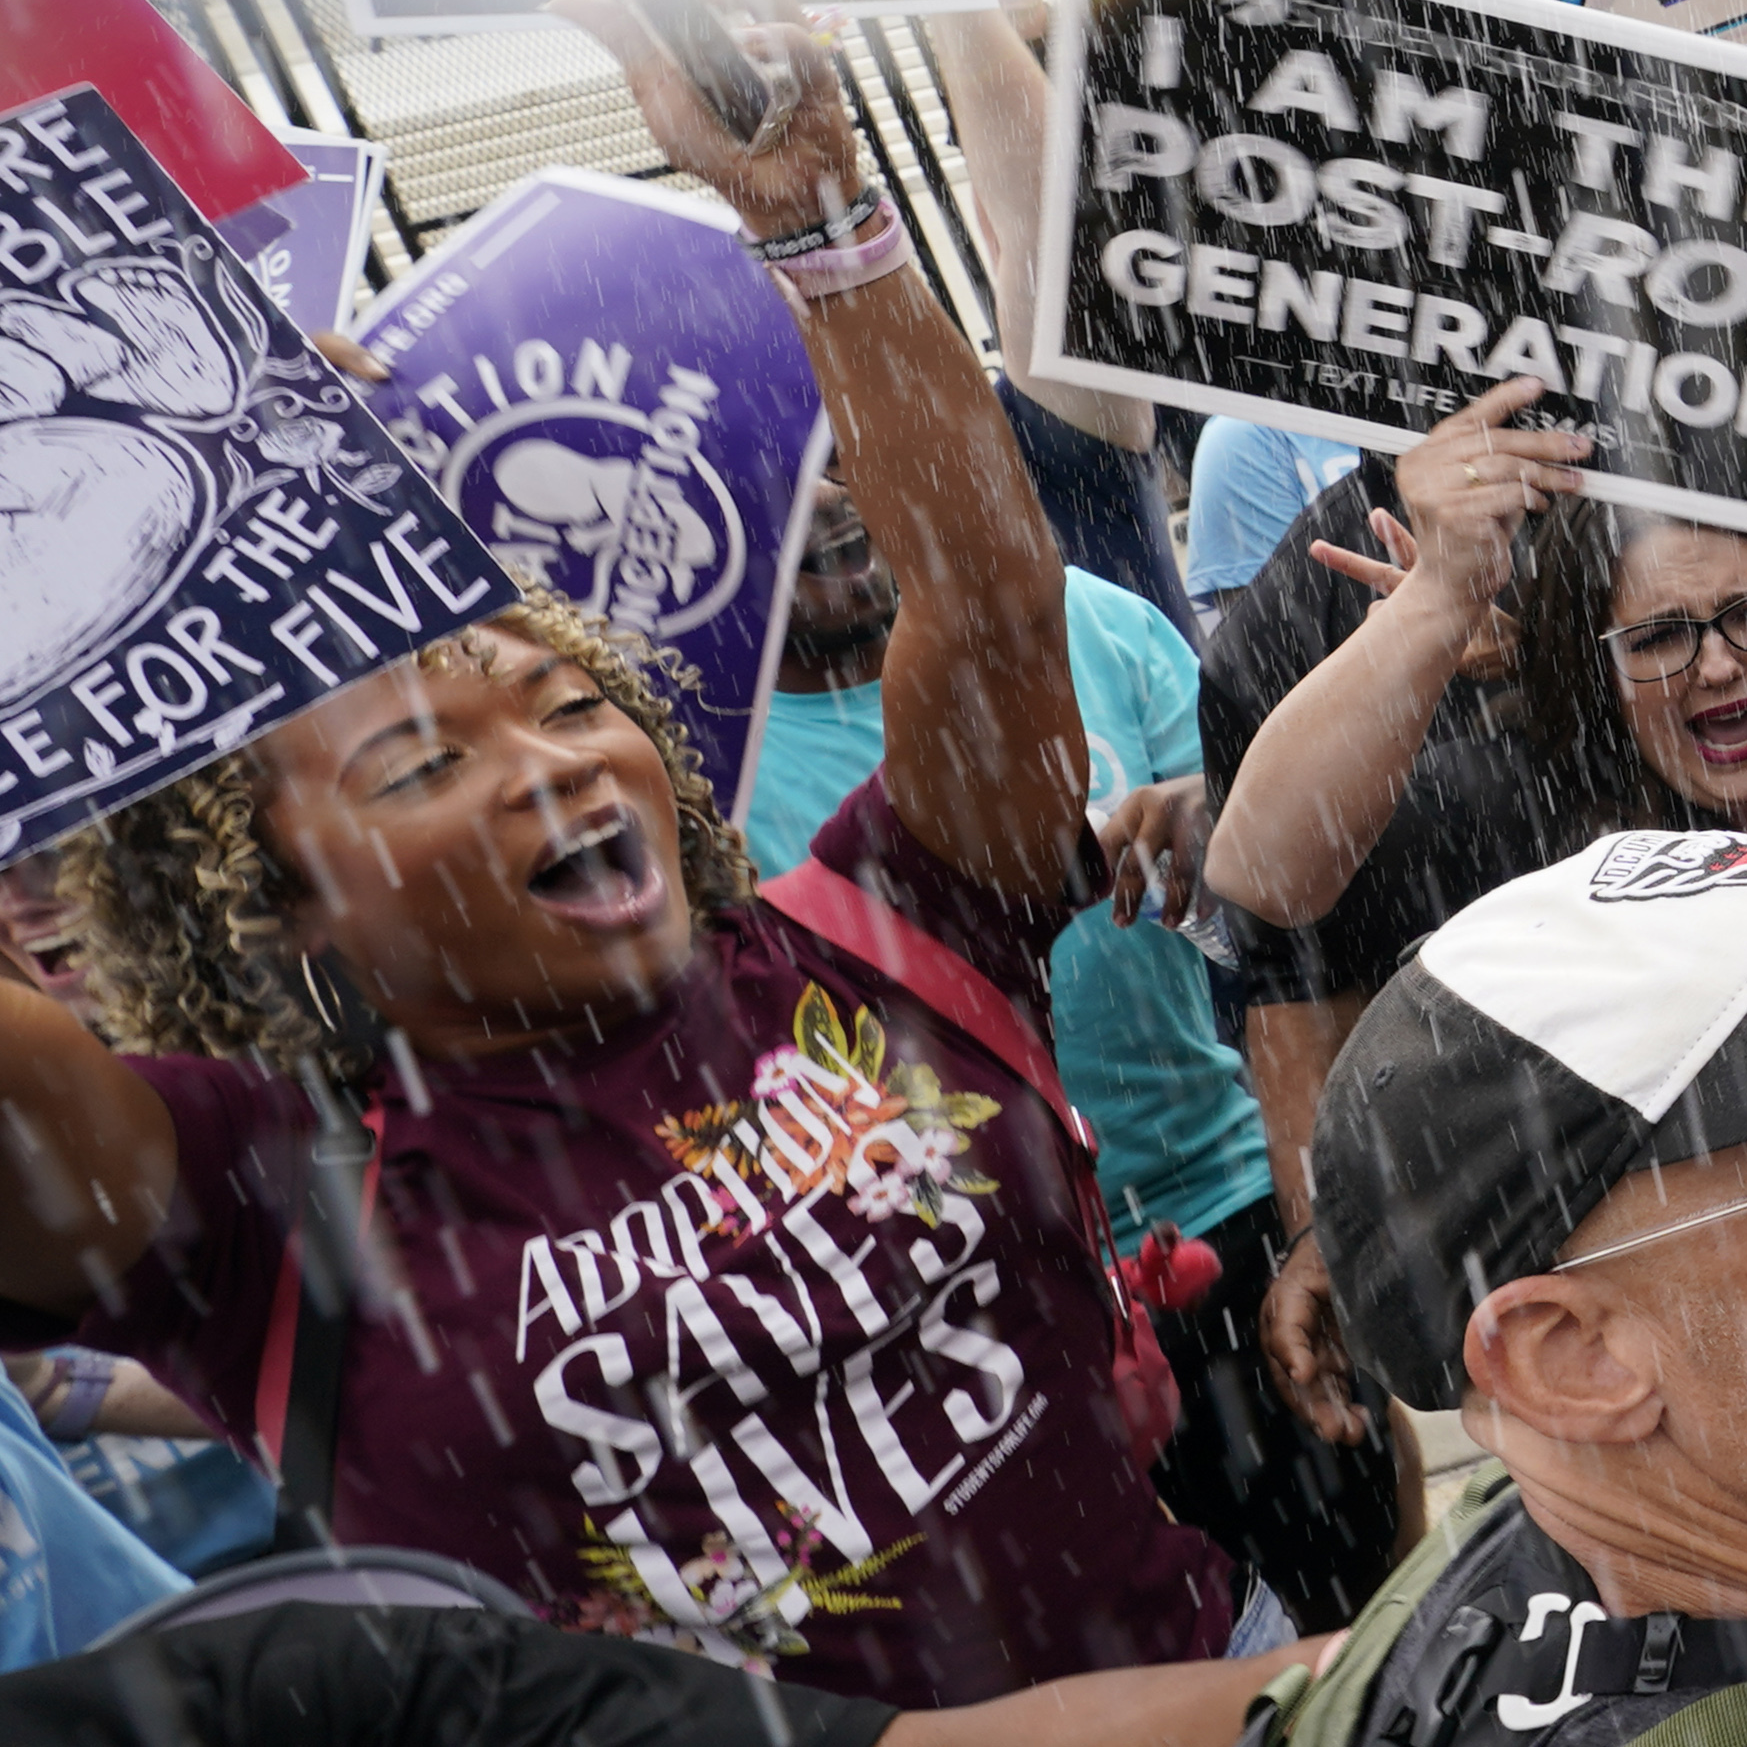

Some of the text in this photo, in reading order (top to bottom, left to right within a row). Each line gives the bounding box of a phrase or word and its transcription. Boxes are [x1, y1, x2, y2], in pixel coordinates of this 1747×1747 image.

[1140, 14, 1184, 91] I
[1248, 49, 1492, 163] AM
[1386, 376, 1458, 413] LIFE
[71, 604, 266, 748] FOR
[272, 507, 492, 689] FIVE
[515, 1029, 882, 1364] ADOPTION
[533, 1121, 986, 1507] SAVES
[604, 1259, 1025, 1683] LIVES
